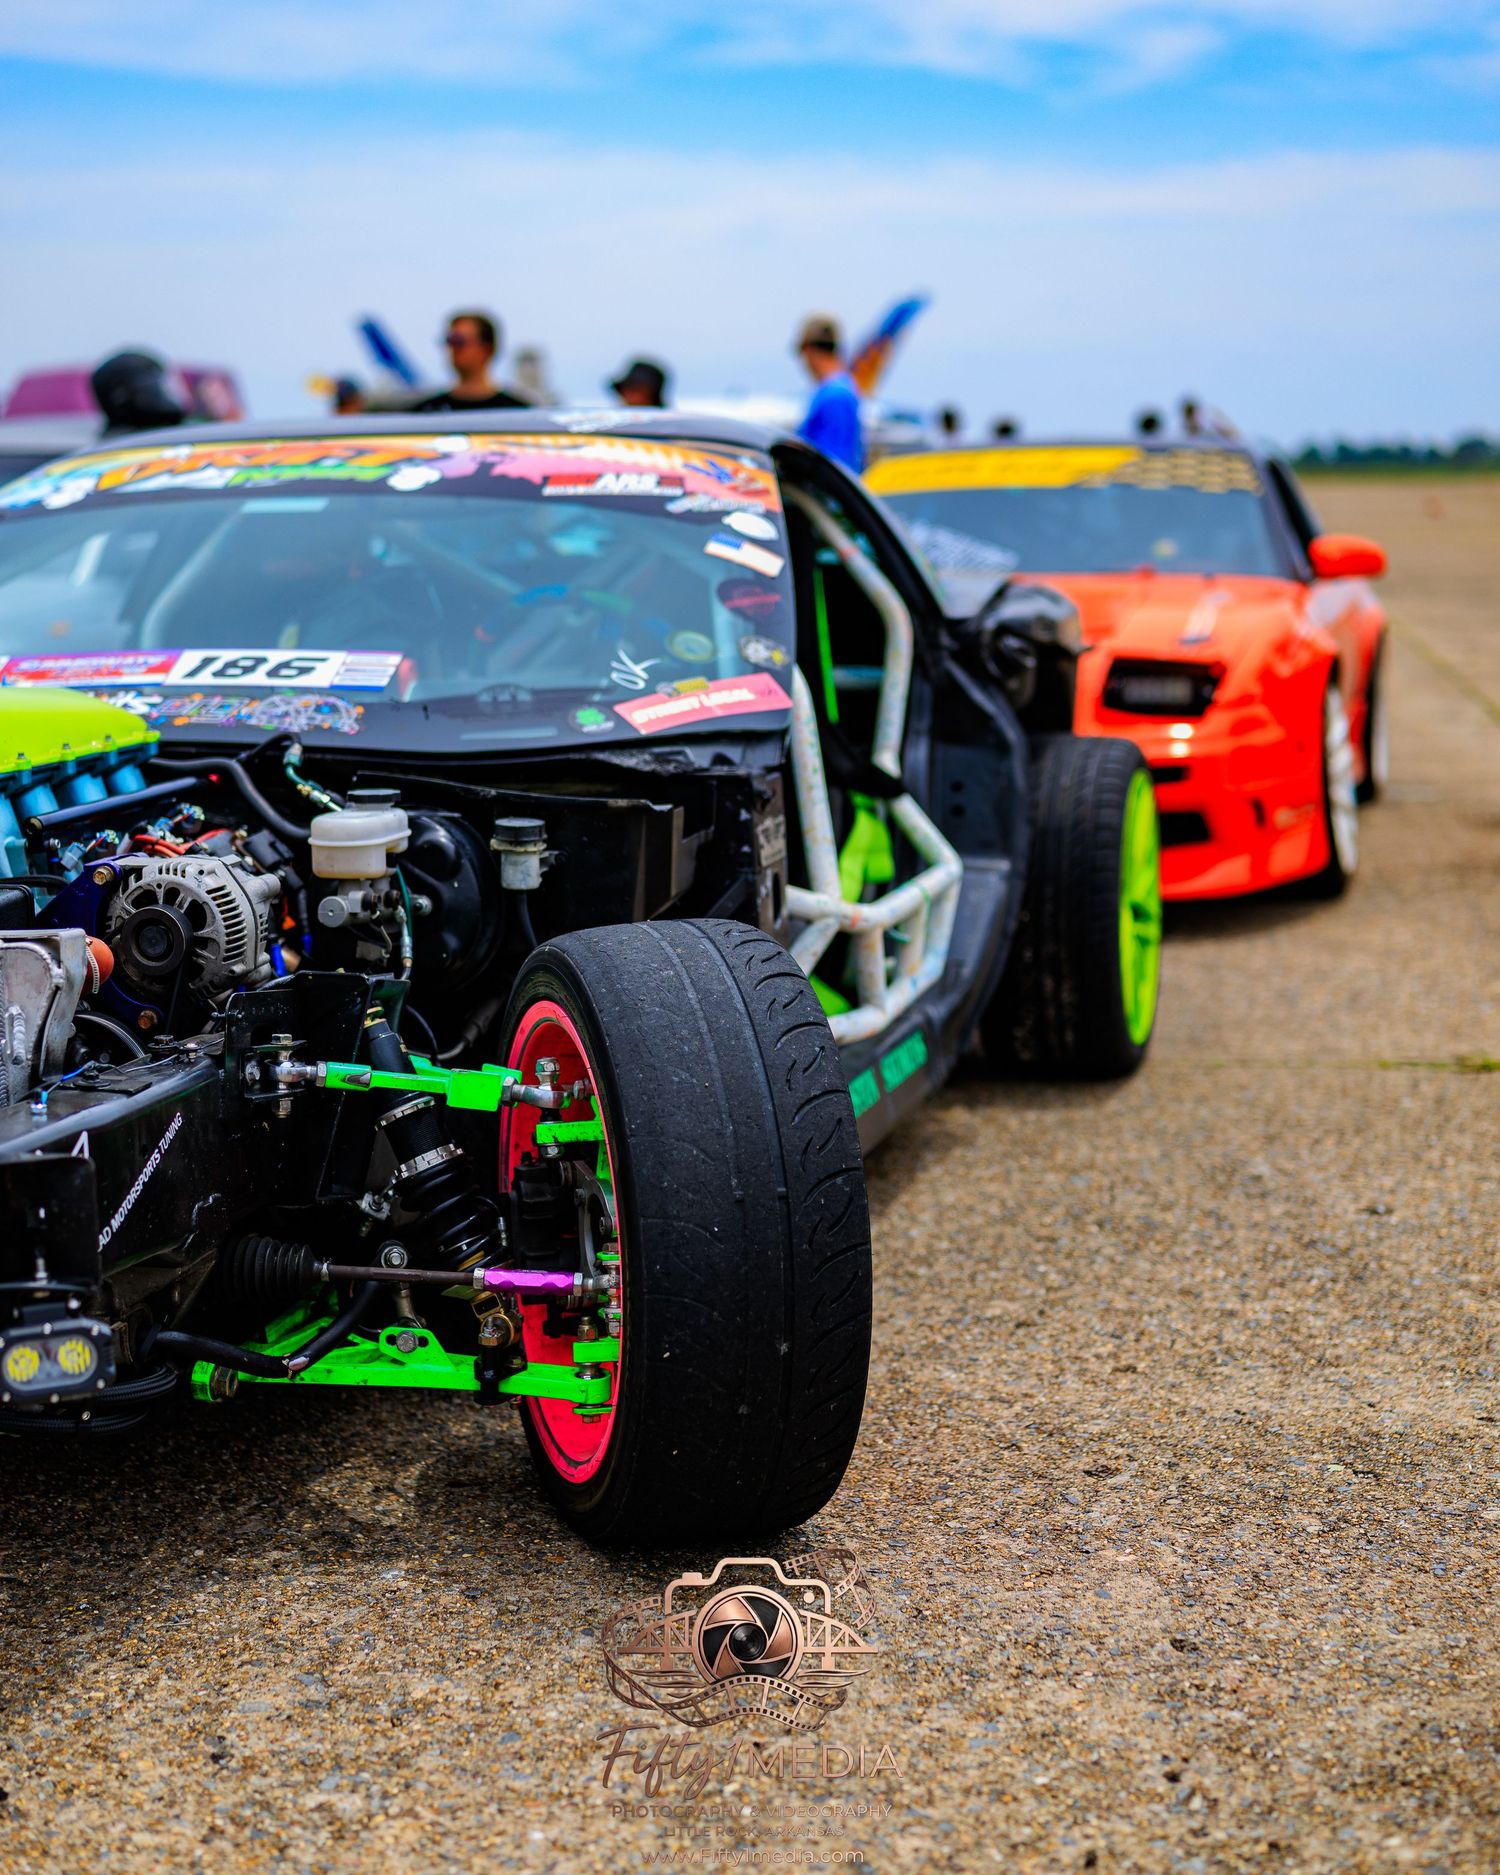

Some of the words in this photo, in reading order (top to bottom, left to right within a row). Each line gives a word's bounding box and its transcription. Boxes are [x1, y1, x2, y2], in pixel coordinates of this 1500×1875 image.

[182, 655, 330, 679] 186
[110, 1149, 161, 1232] MOTORSPORTS
[158, 1112, 183, 1154] TUNING
